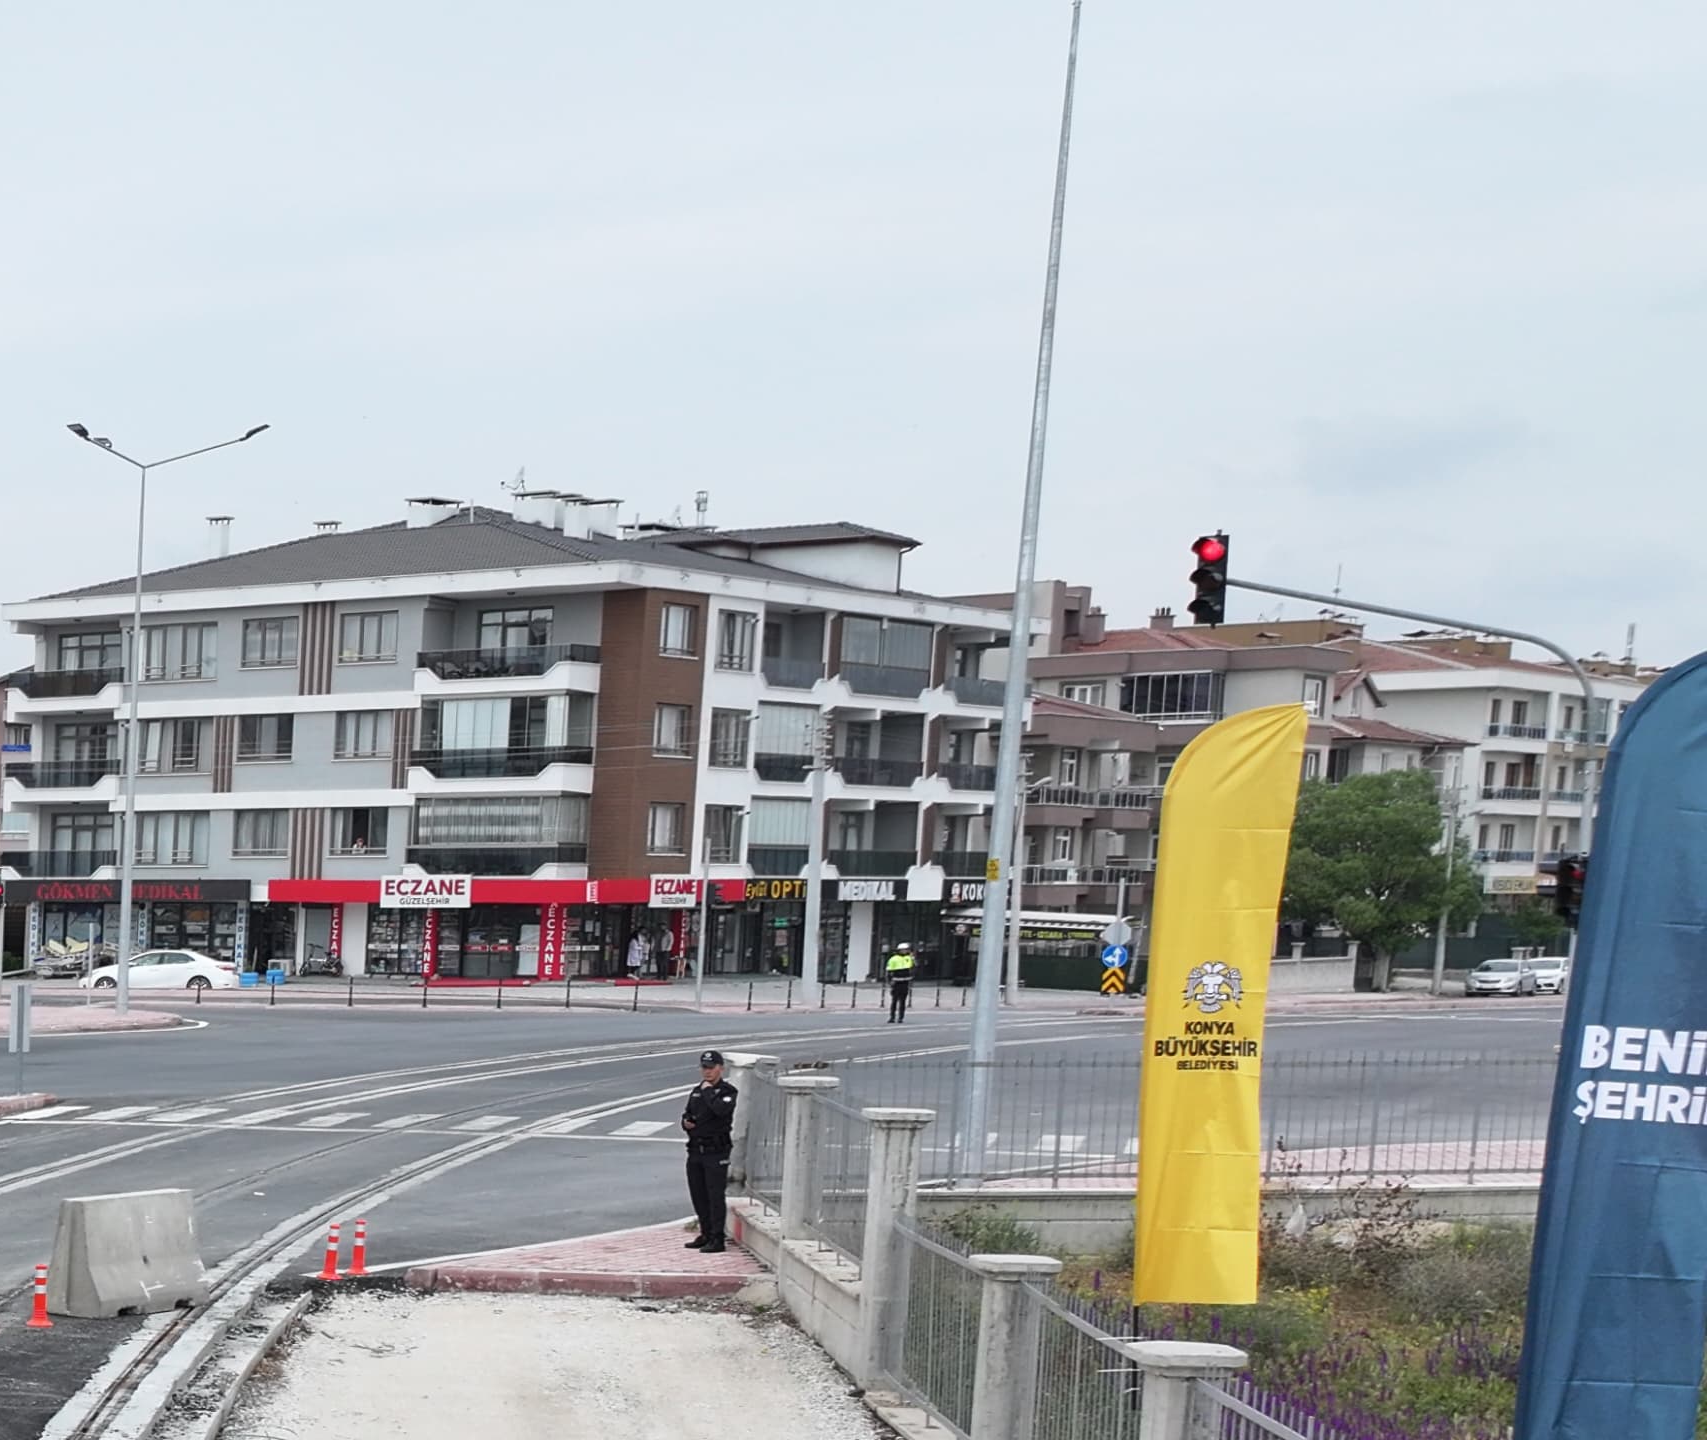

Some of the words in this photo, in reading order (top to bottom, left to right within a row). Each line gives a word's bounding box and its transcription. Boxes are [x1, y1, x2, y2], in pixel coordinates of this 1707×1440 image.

[37, 882, 113, 900] GÖKMEN
[384, 879, 466, 897] ECZANE
[654, 878, 697, 895] ECZANE
[771, 880, 807, 898] OPTİ
[838, 880, 896, 901] MEDİKAL
[960, 883, 987, 901] KOK
[544, 907, 557, 976] ECZANE
[1184, 1021, 1235, 1035] KONYA
[1153, 1036, 1259, 1059] BÜYÜKŞEHİR
[1579, 1023, 1707, 1076] BENİ
[1176, 1060, 1239, 1071] BELEDİYESİ
[1572, 1080, 1707, 1125] ŞEHRİ
